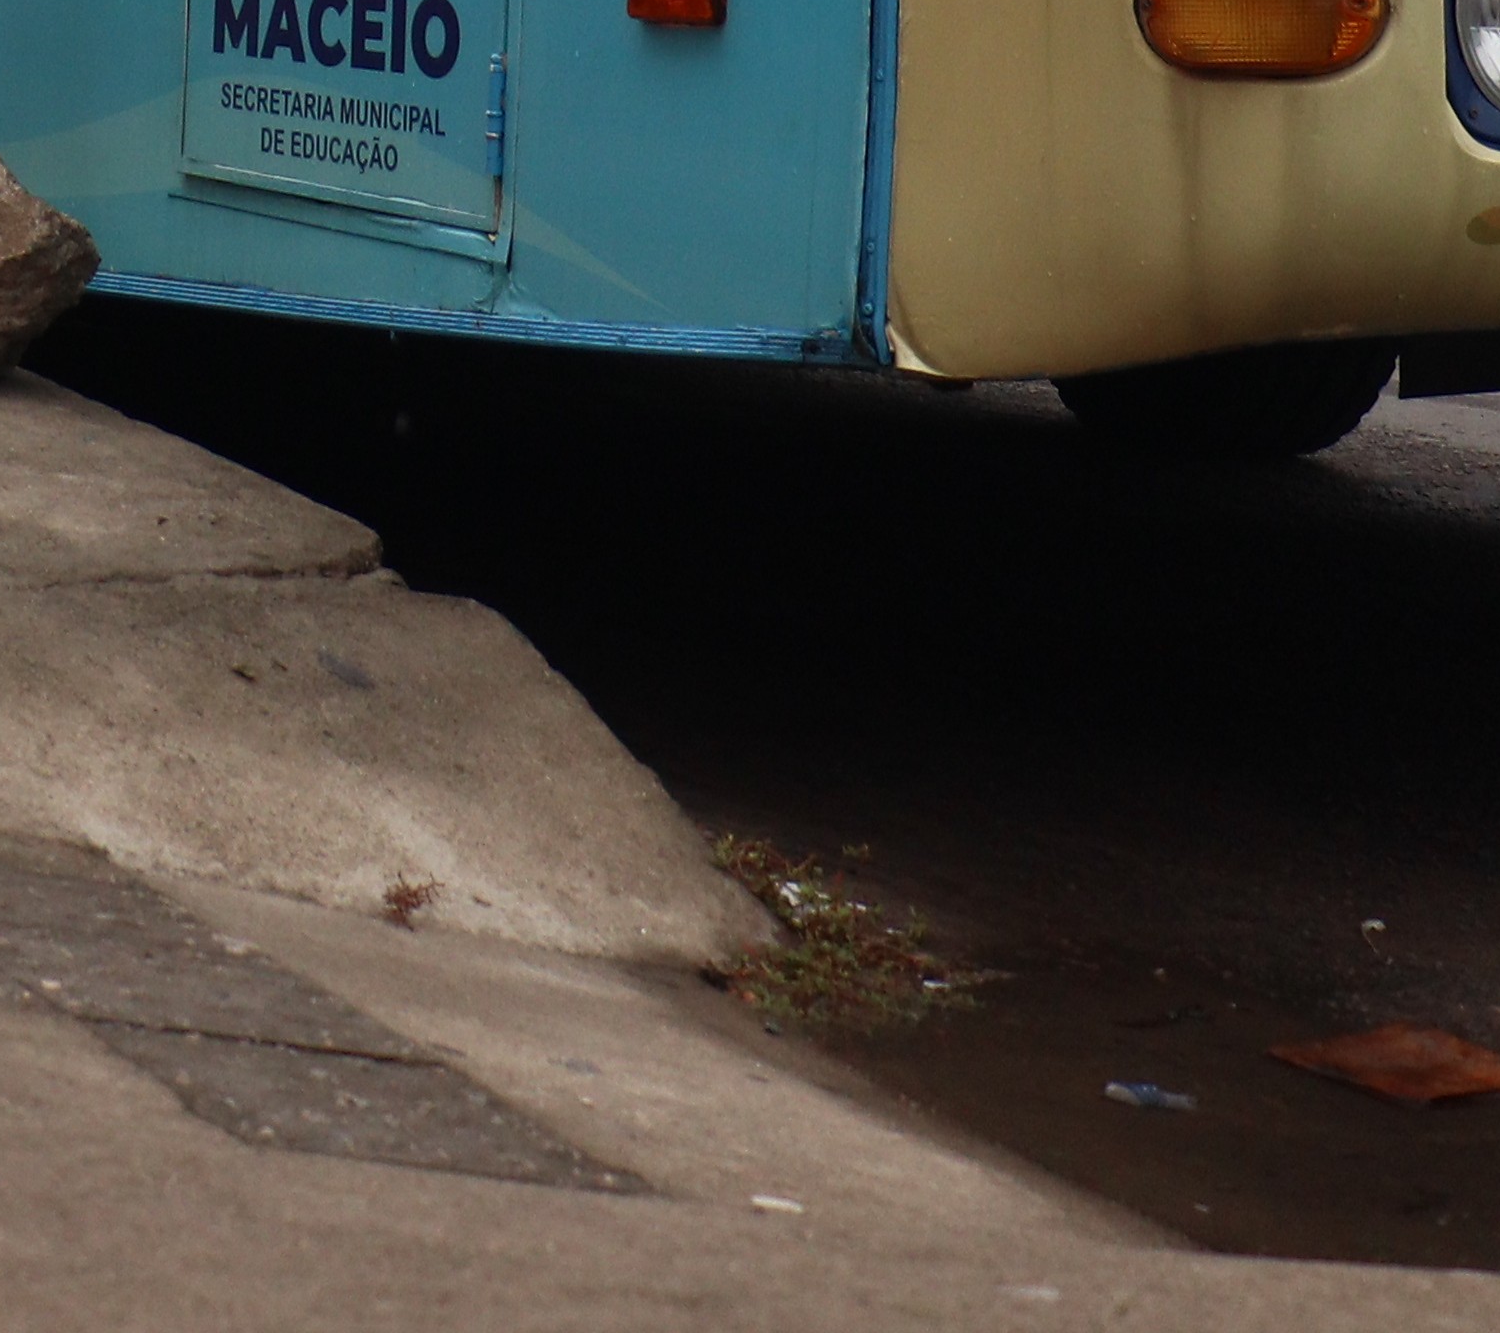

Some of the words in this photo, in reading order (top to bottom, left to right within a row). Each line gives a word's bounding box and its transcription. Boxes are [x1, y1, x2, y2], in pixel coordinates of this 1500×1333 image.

[220, 82, 335, 122] SECRETARIA
[340, 97, 446, 137] MUNICIPAL
[261, 127, 284, 156] DE
[291, 130, 398, 174] EDUCAÇÃO
